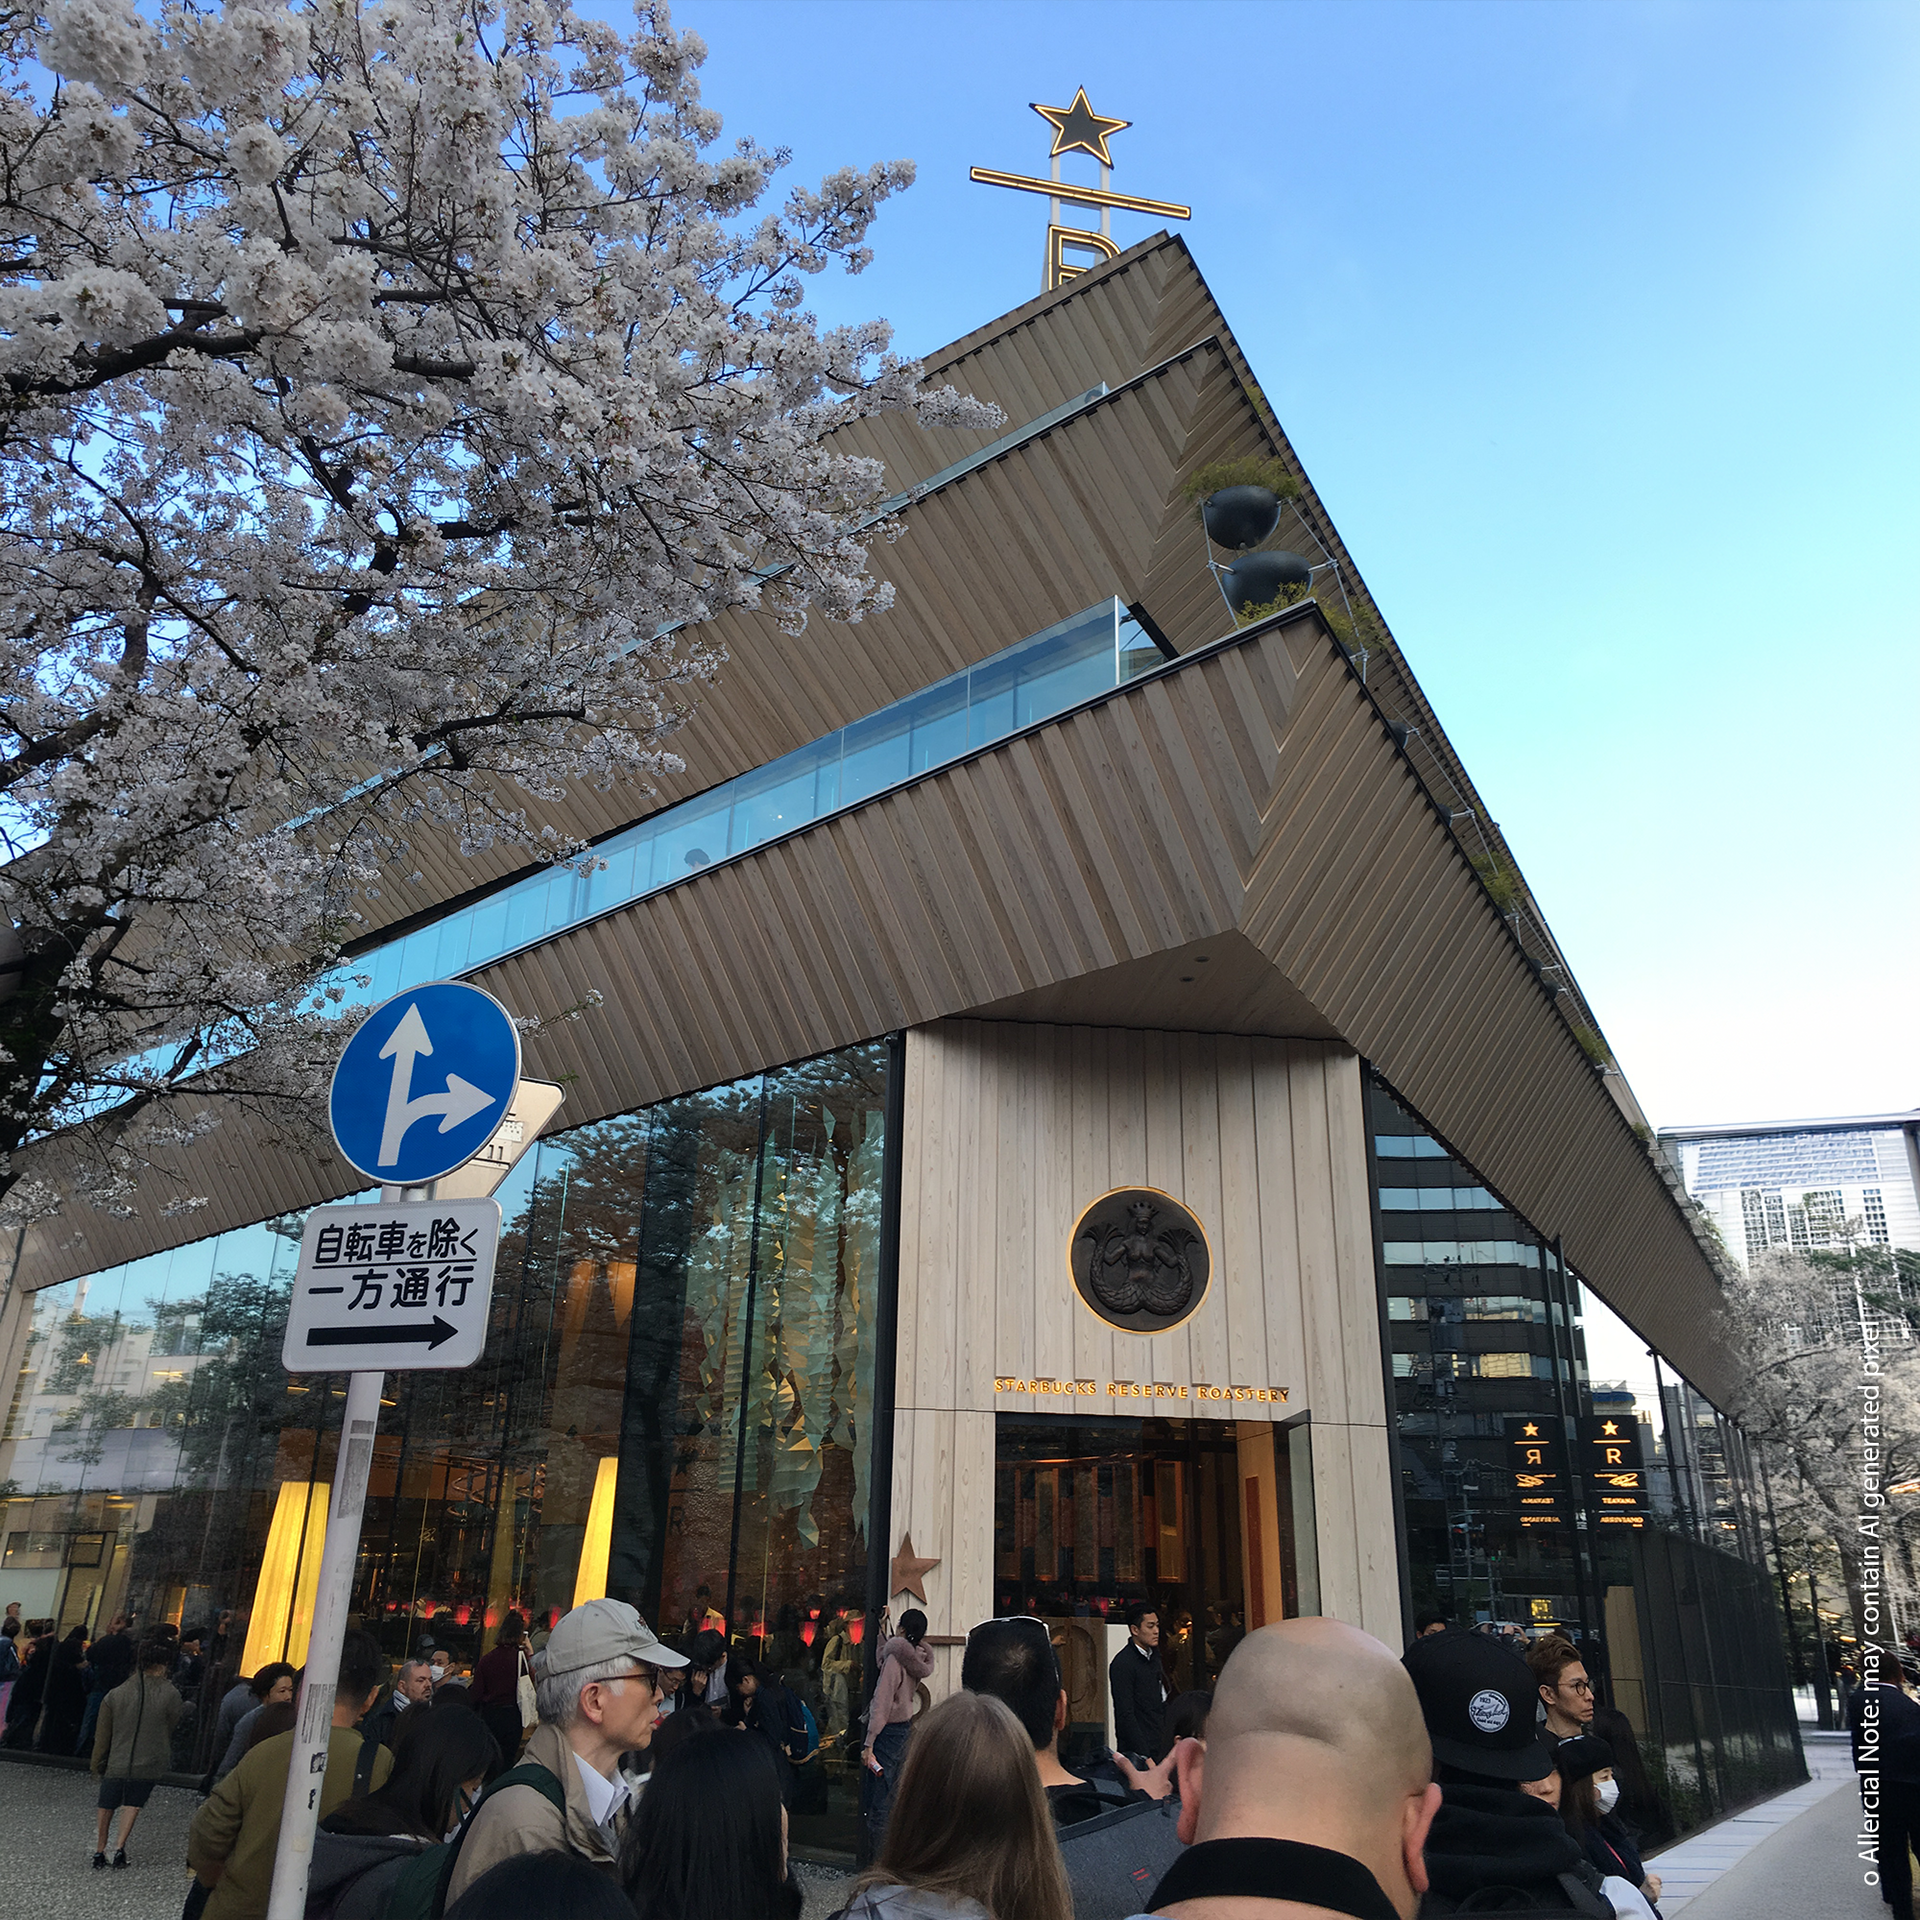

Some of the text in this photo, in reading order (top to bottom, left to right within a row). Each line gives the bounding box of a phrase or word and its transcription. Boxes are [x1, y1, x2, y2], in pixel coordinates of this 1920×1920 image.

[315, 1218, 478, 1263] 自転車を除く
[308, 1265, 474, 1311] 一方通行
[994, 1378, 1290, 1403] STARBUCKS RESERVE ROASTERY
[1606, 1448, 1622, 1464] R
